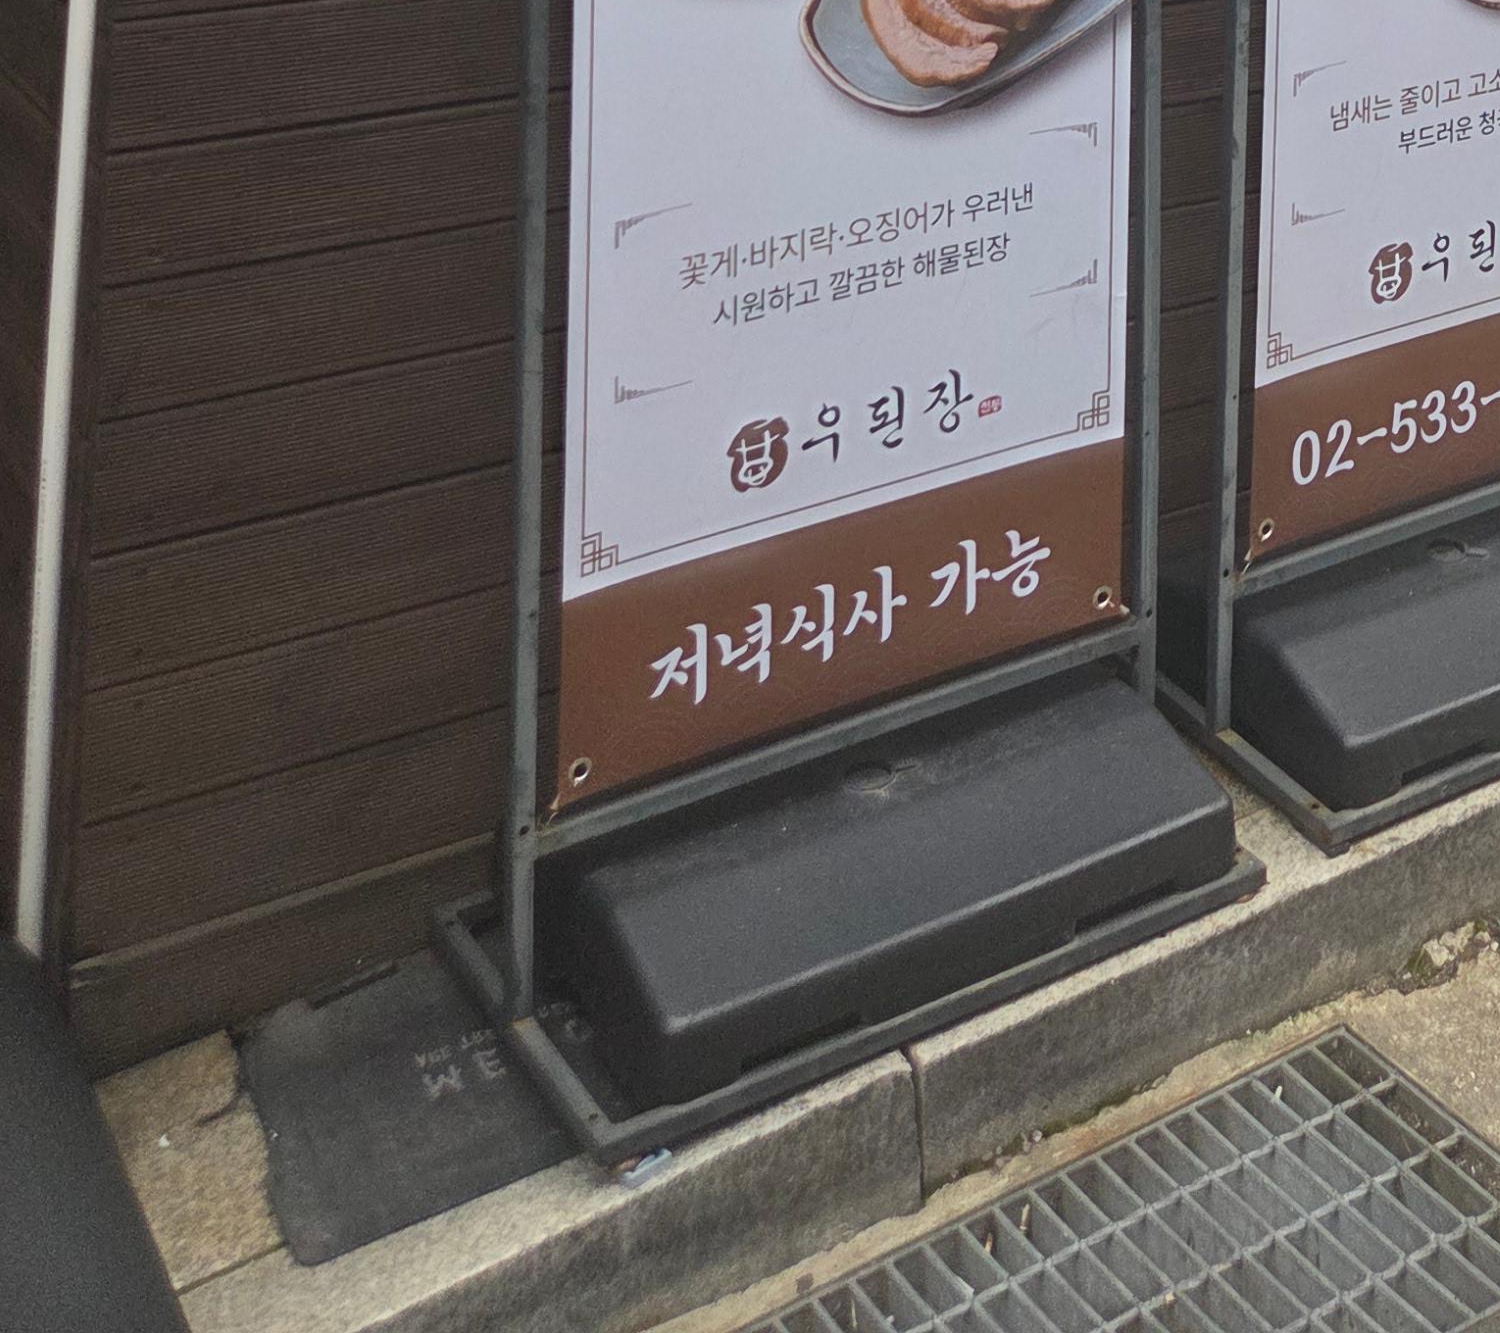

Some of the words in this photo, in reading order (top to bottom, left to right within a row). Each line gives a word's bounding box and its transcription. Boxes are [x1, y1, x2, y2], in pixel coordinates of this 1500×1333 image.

[1330, 91, 1393, 132] 냄새는
[1399, 77, 1463, 116] 줄이고
[1397, 114, 1474, 155] 부드러운
[961, 181, 1036, 229] 우러낸
[712, 276, 821, 327] 시원하고
[827, 257, 905, 302] 깔끔한
[912, 232, 1011, 278] 해물된장
[648, 564, 909, 707] 저녁식사
[927, 529, 1051, 616] 가능
